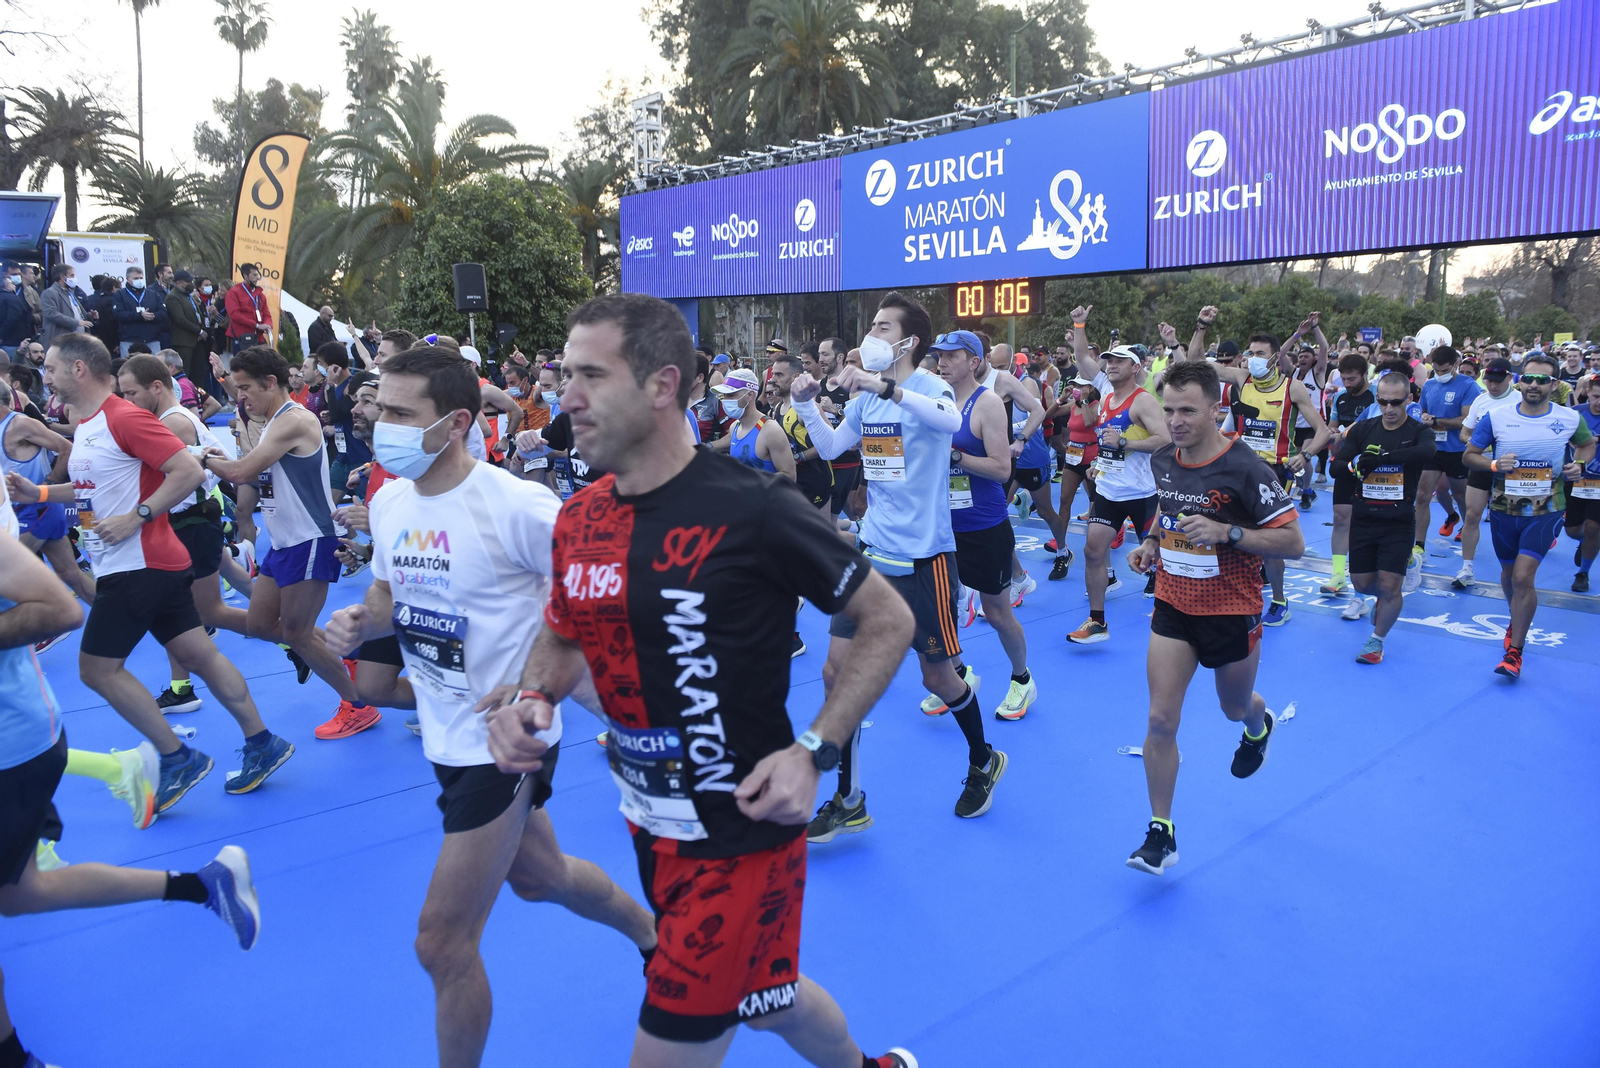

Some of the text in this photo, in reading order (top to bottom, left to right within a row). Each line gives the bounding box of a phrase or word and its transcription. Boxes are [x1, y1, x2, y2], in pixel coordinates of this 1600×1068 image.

[906, 148, 1004, 191] ZURICH
[1404, 170, 1418, 181] DE
[1421, 164, 1463, 179] SEVILLA
[905, 188, 1005, 230] MARATÓN
[1153, 181, 1263, 221] ZURICH
[247, 214, 279, 234] IMD
[237, 235, 285, 250] Instituto Municipal
[253, 245, 276, 255] Deportes
[635, 237, 654, 252] asics
[779, 238, 834, 260] ZURICH
[904, 225, 1007, 263] SEVILLA
[863, 426, 894, 435] ZURICH
[866, 444, 883, 453] 4585
[1192, 505, 1216, 514] Utrera
[1174, 539, 1194, 551] 5796
[392, 555, 450, 572] MARATÓN
[405, 572, 450, 590] cabberty
[412, 613, 457, 633] ZURICH
[660, 588, 738, 794] MARATÓN
